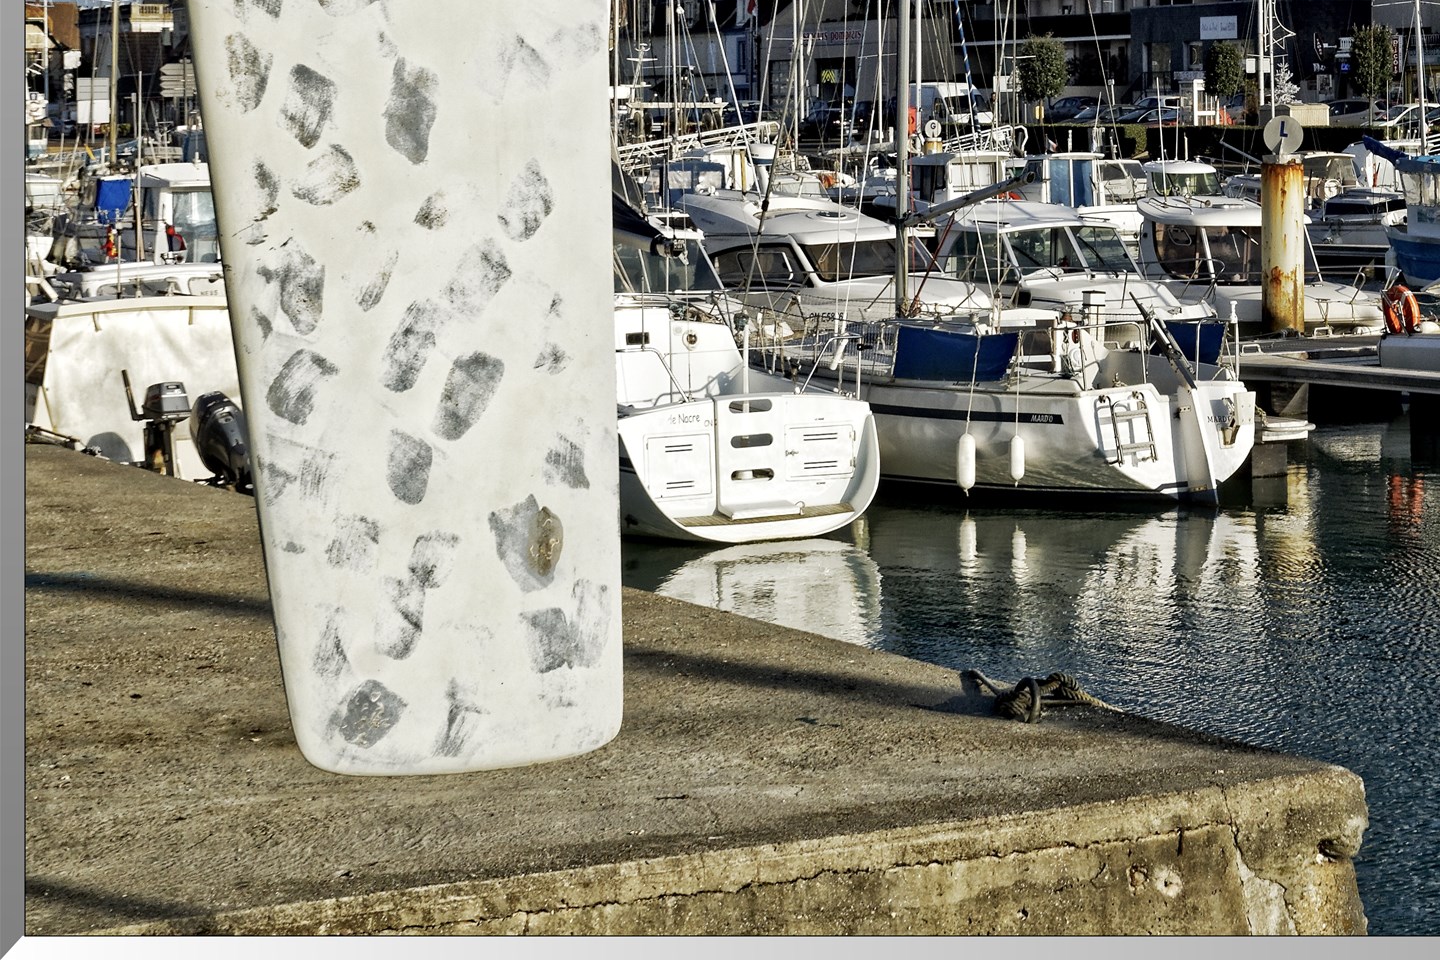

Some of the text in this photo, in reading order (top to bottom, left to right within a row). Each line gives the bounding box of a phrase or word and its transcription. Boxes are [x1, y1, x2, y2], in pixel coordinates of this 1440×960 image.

[930, 122, 937, 130] G
[1279, 120, 1289, 138] L
[678, 413, 701, 424] Nacre
